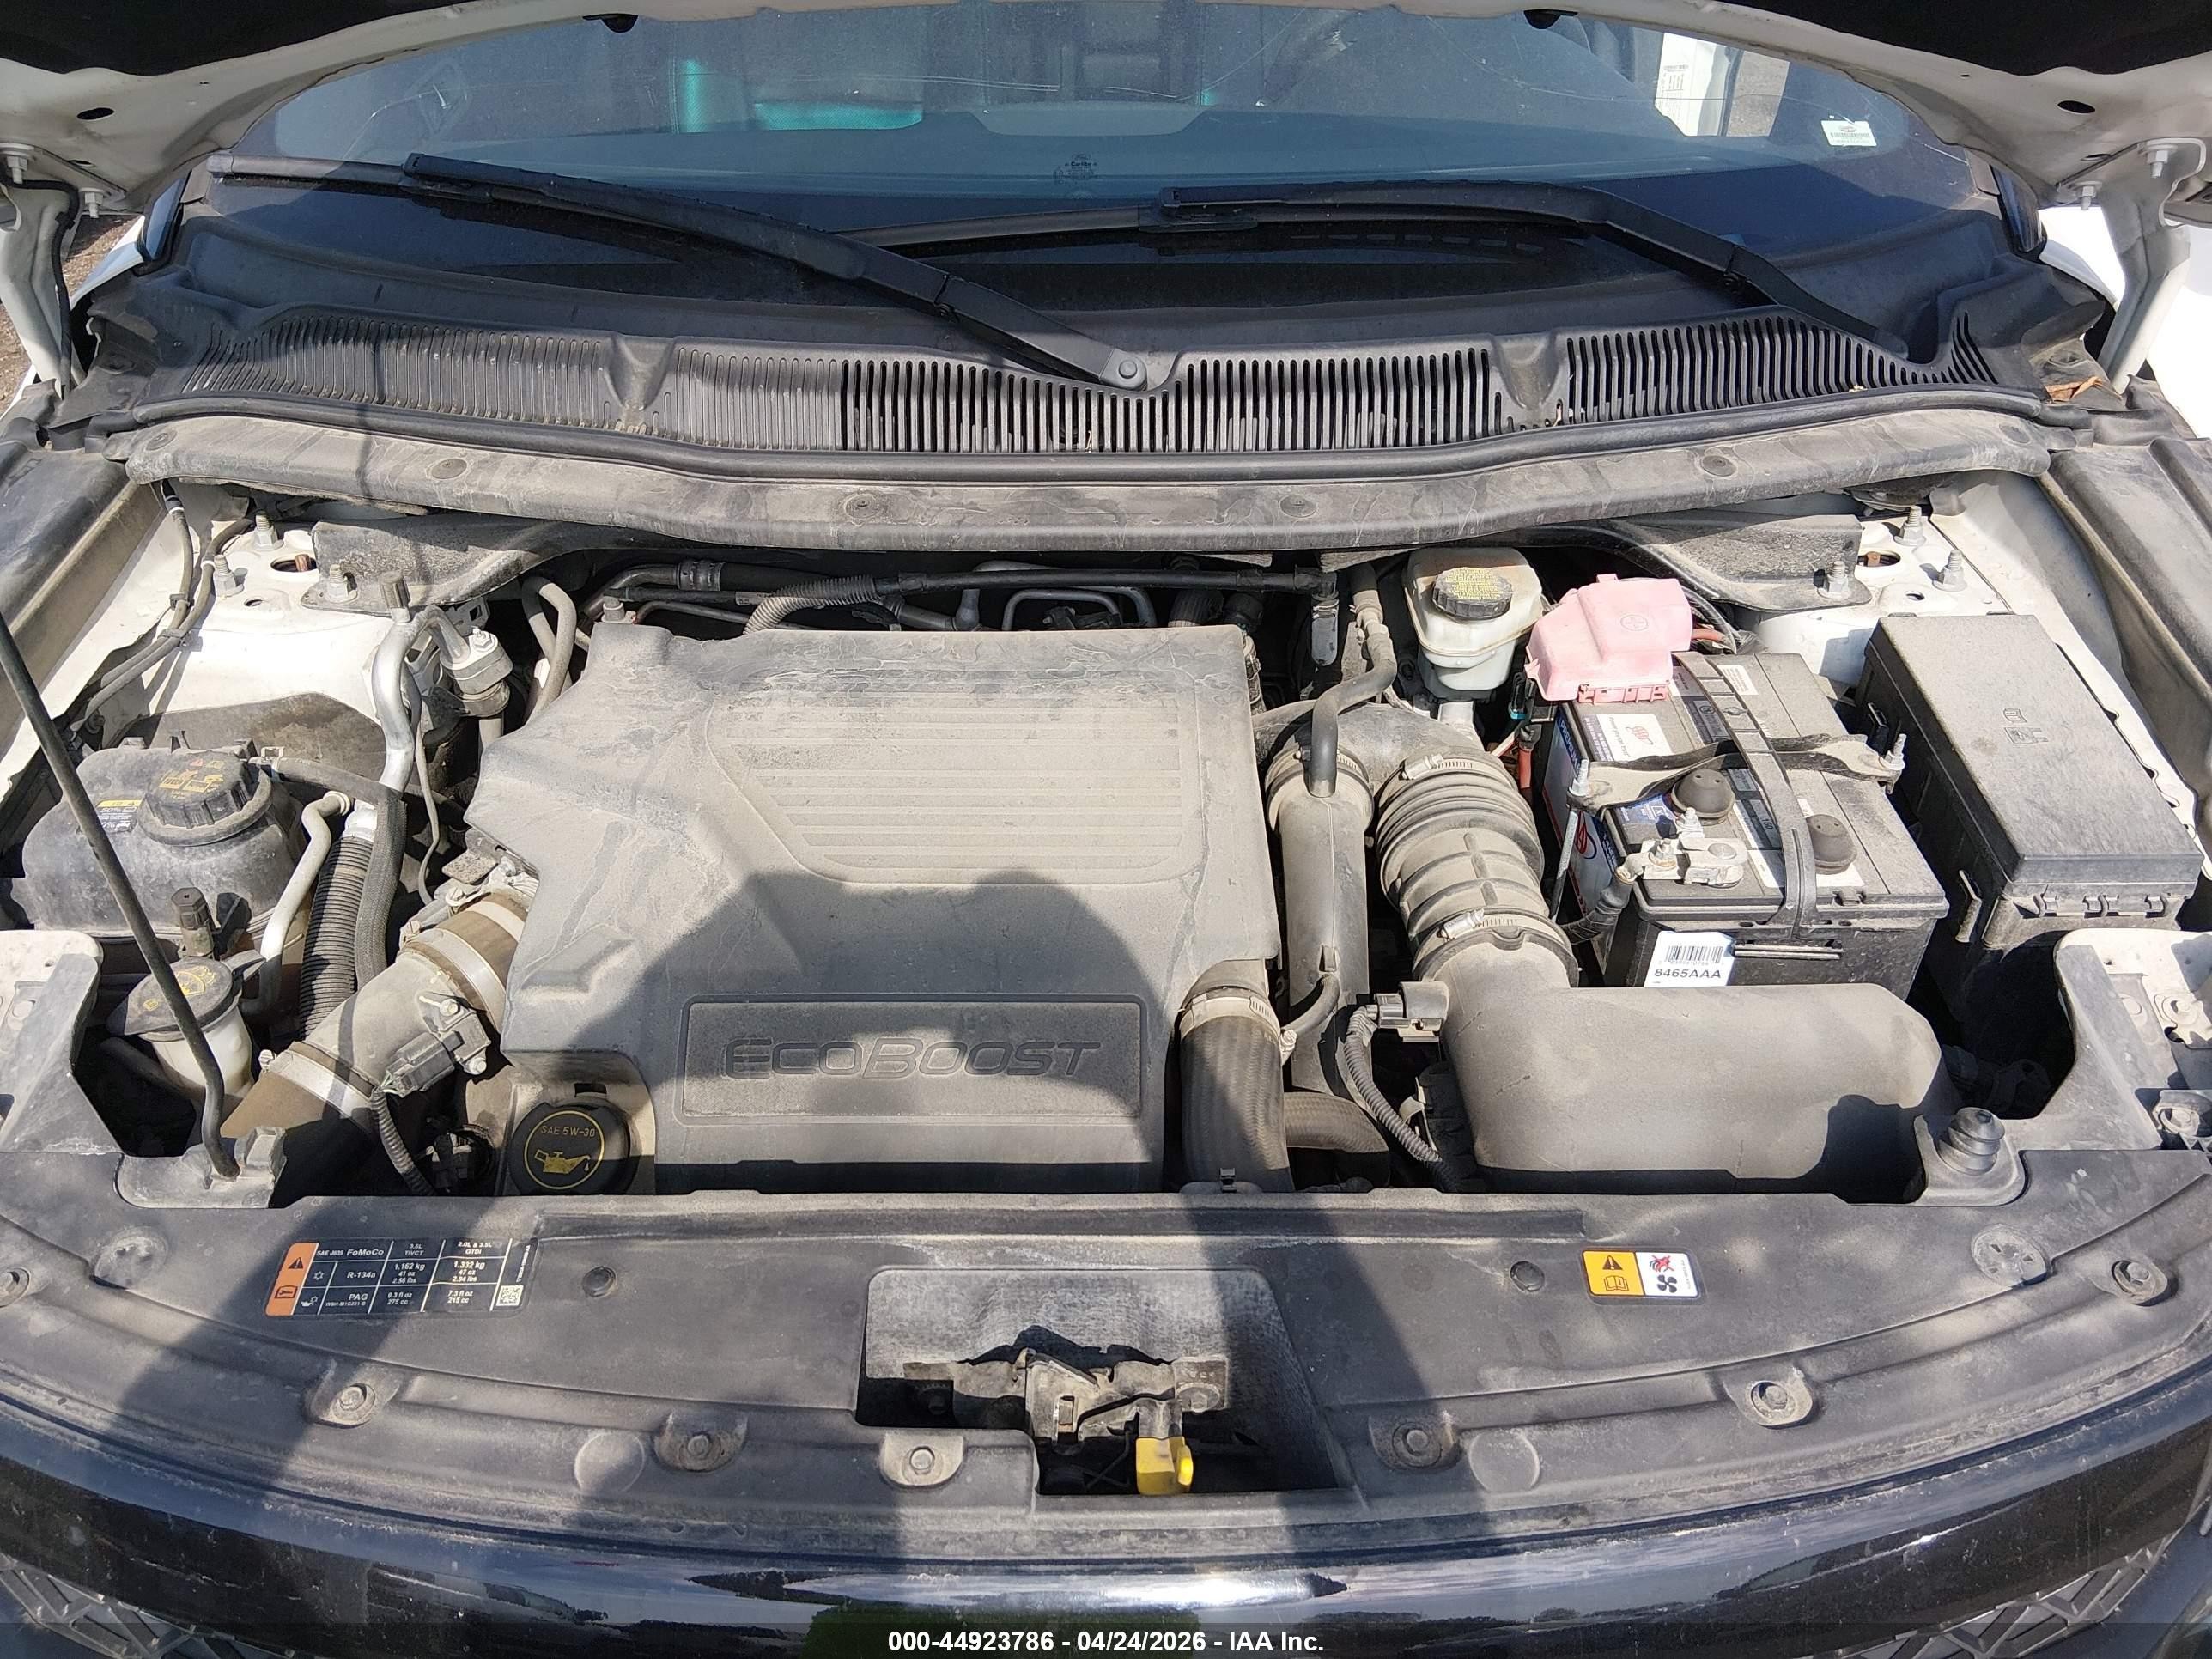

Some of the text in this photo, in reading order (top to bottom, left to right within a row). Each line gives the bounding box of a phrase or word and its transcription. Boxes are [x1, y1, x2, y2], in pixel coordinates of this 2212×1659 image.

[1655, 969, 1721, 979] 8465AAA
[541, 1126, 596, 1138] SAE 5W-30
[415, 1262, 425, 1271] kg
[475, 1261, 485, 1270] kg
